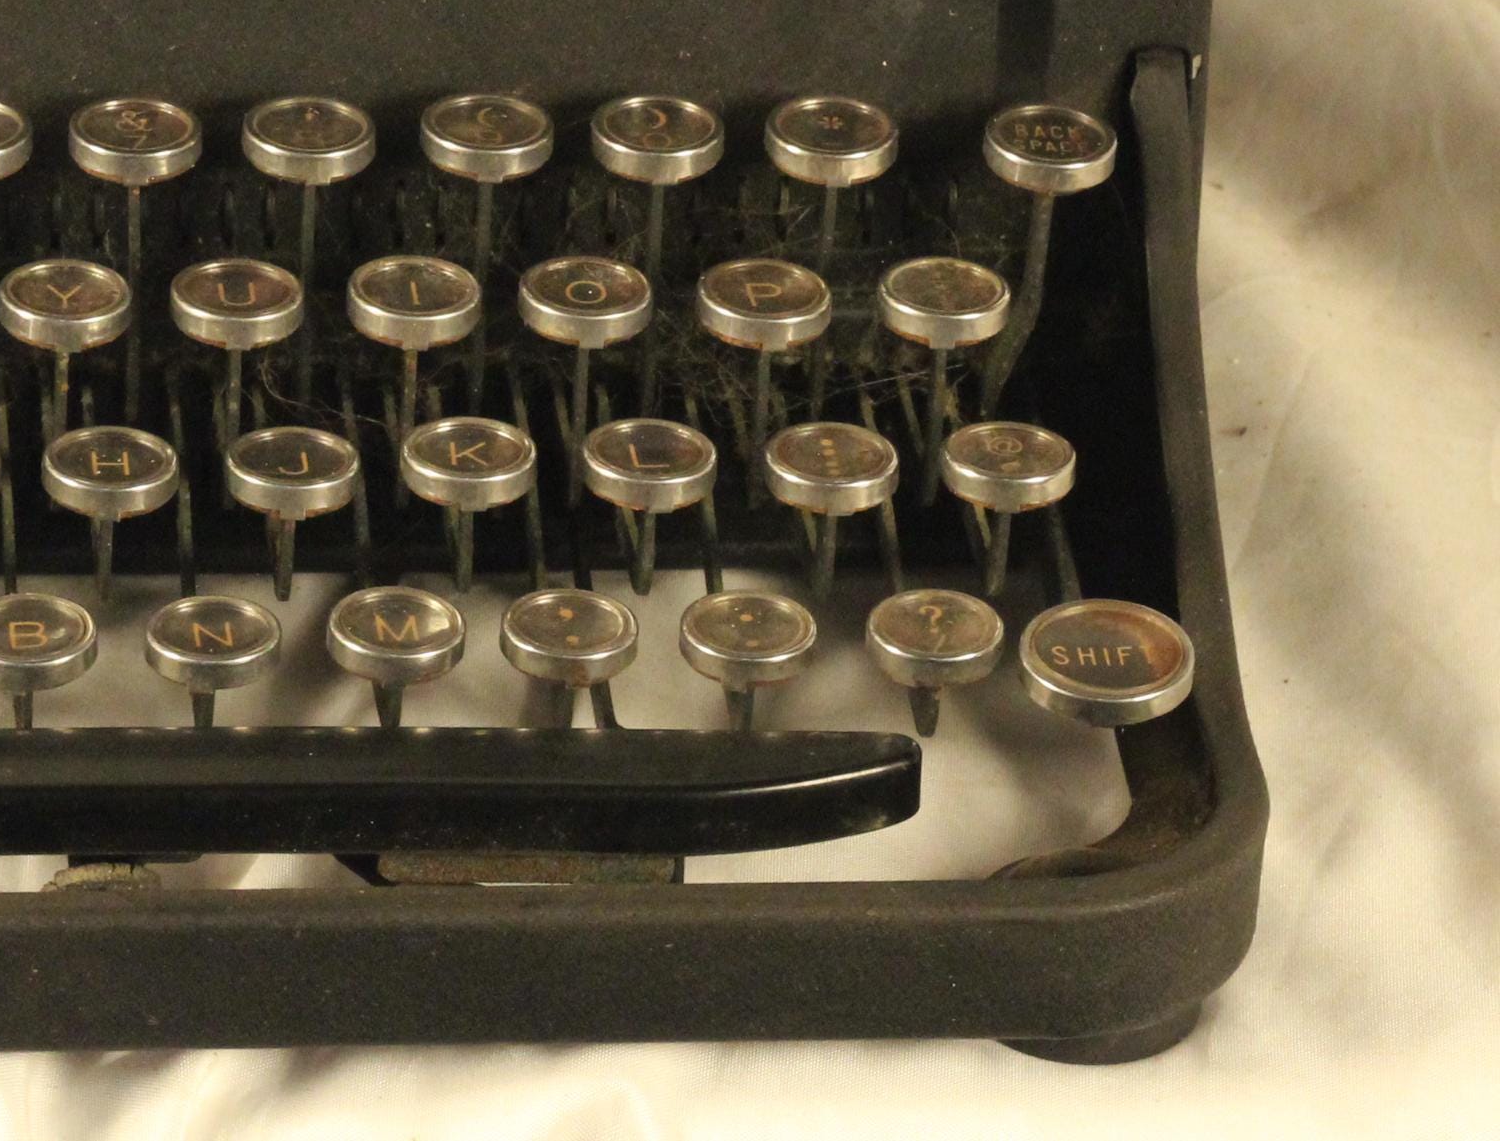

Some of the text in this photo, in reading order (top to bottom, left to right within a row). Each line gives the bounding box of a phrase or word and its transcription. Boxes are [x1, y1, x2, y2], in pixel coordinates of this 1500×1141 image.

[115, 109, 153, 133] &
[1014, 124, 1082, 139] BACK
[122, 134, 147, 150] 7
[46, 283, 83, 309] Y
[217, 281, 257, 307] U
[409, 280, 421, 306] I
[565, 280, 607, 304] O
[744, 283, 782, 307] P
[90, 450, 131, 477] H
[277, 451, 309, 475] J
[449, 441, 489, 467] K
[628, 443, 671, 469] L
[373, 612, 421, 642] M
[918, 604, 943, 636] ?
[7, 621, 49, 650] B
[192, 621, 234, 649] N
[1051, 644, 1157, 667] SHIFT
